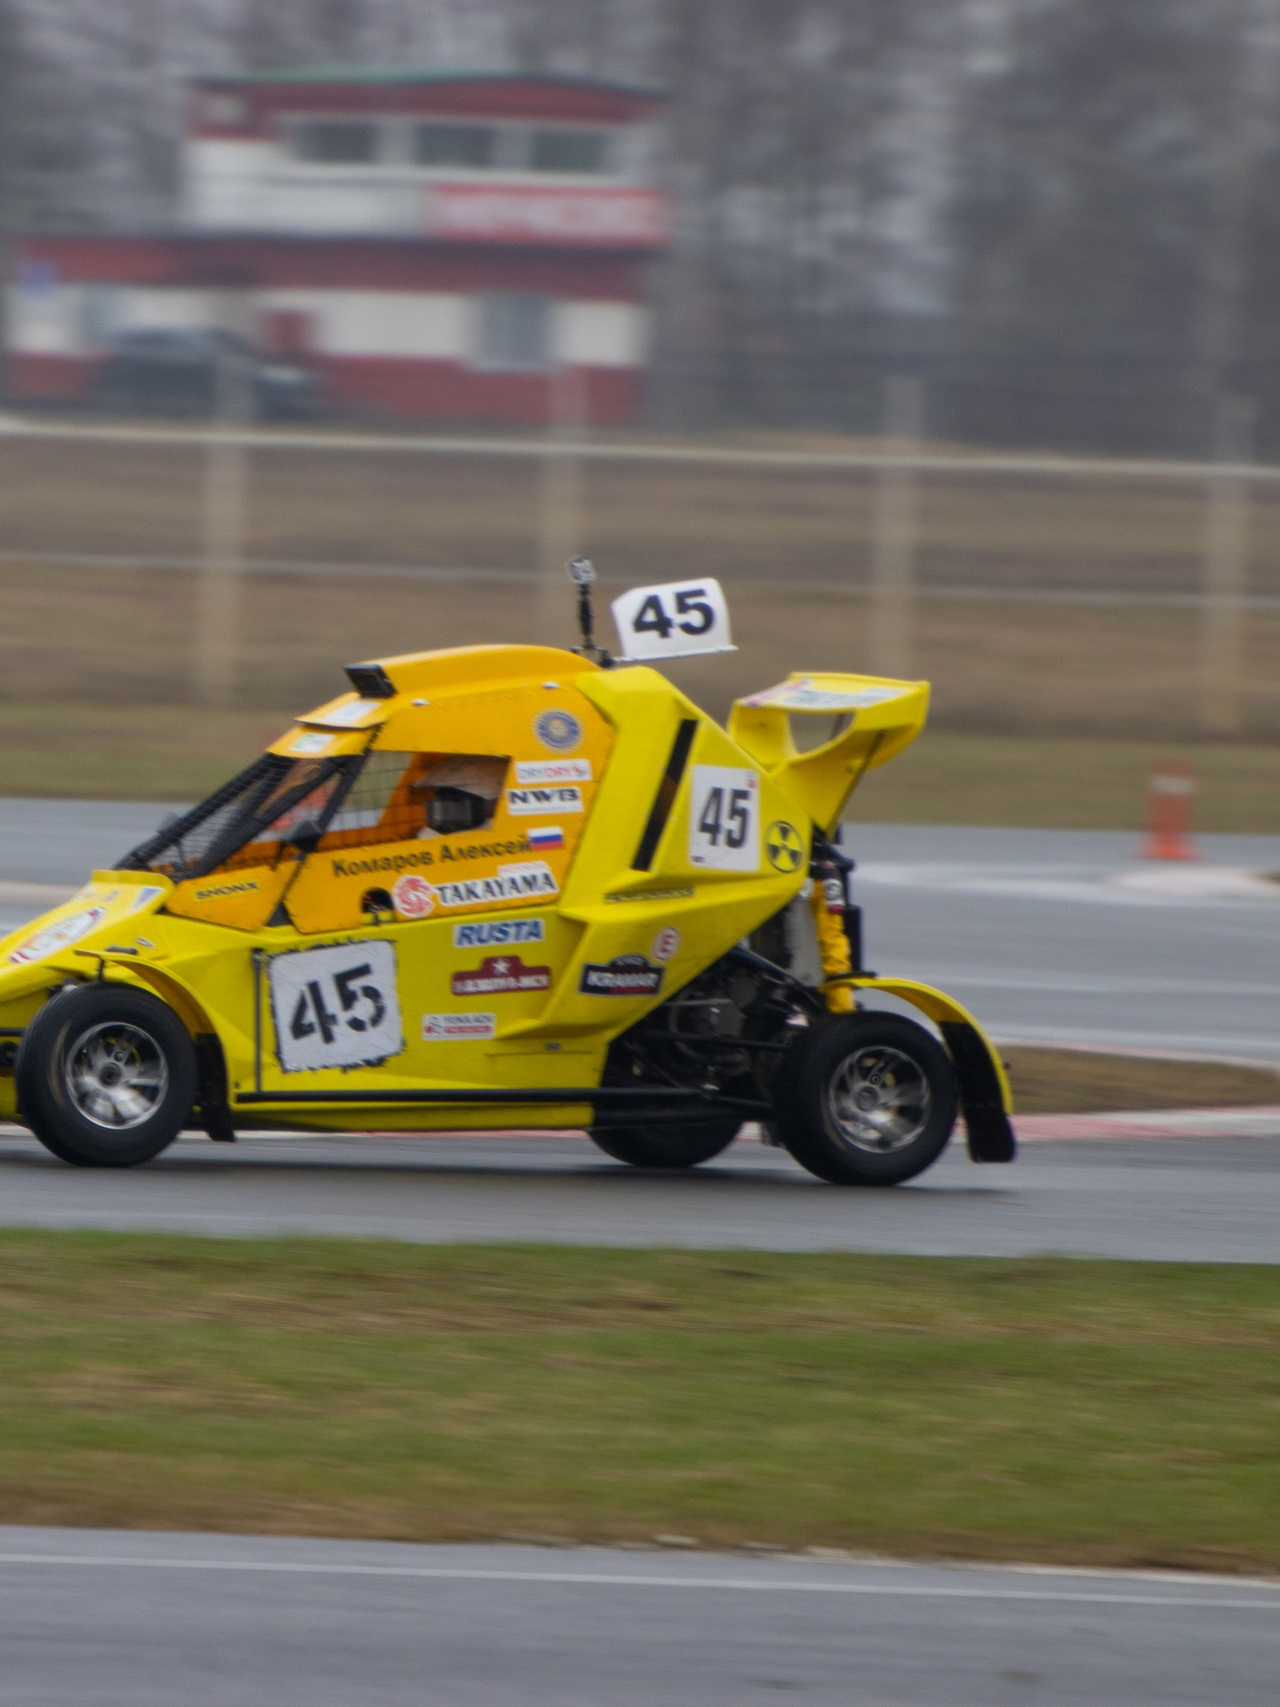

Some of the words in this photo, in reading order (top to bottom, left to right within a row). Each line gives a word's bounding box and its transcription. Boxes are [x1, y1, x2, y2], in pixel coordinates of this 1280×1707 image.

[633, 588, 715, 638] 45
[509, 788, 578, 804] NWB
[698, 787, 752, 848] 45
[332, 850, 433, 877] Комаров
[440, 834, 532, 862] Алексей
[437, 872, 557, 904] TAKAYAMA
[457, 920, 541, 946] RUSTA
[291, 962, 386, 1044] 45
